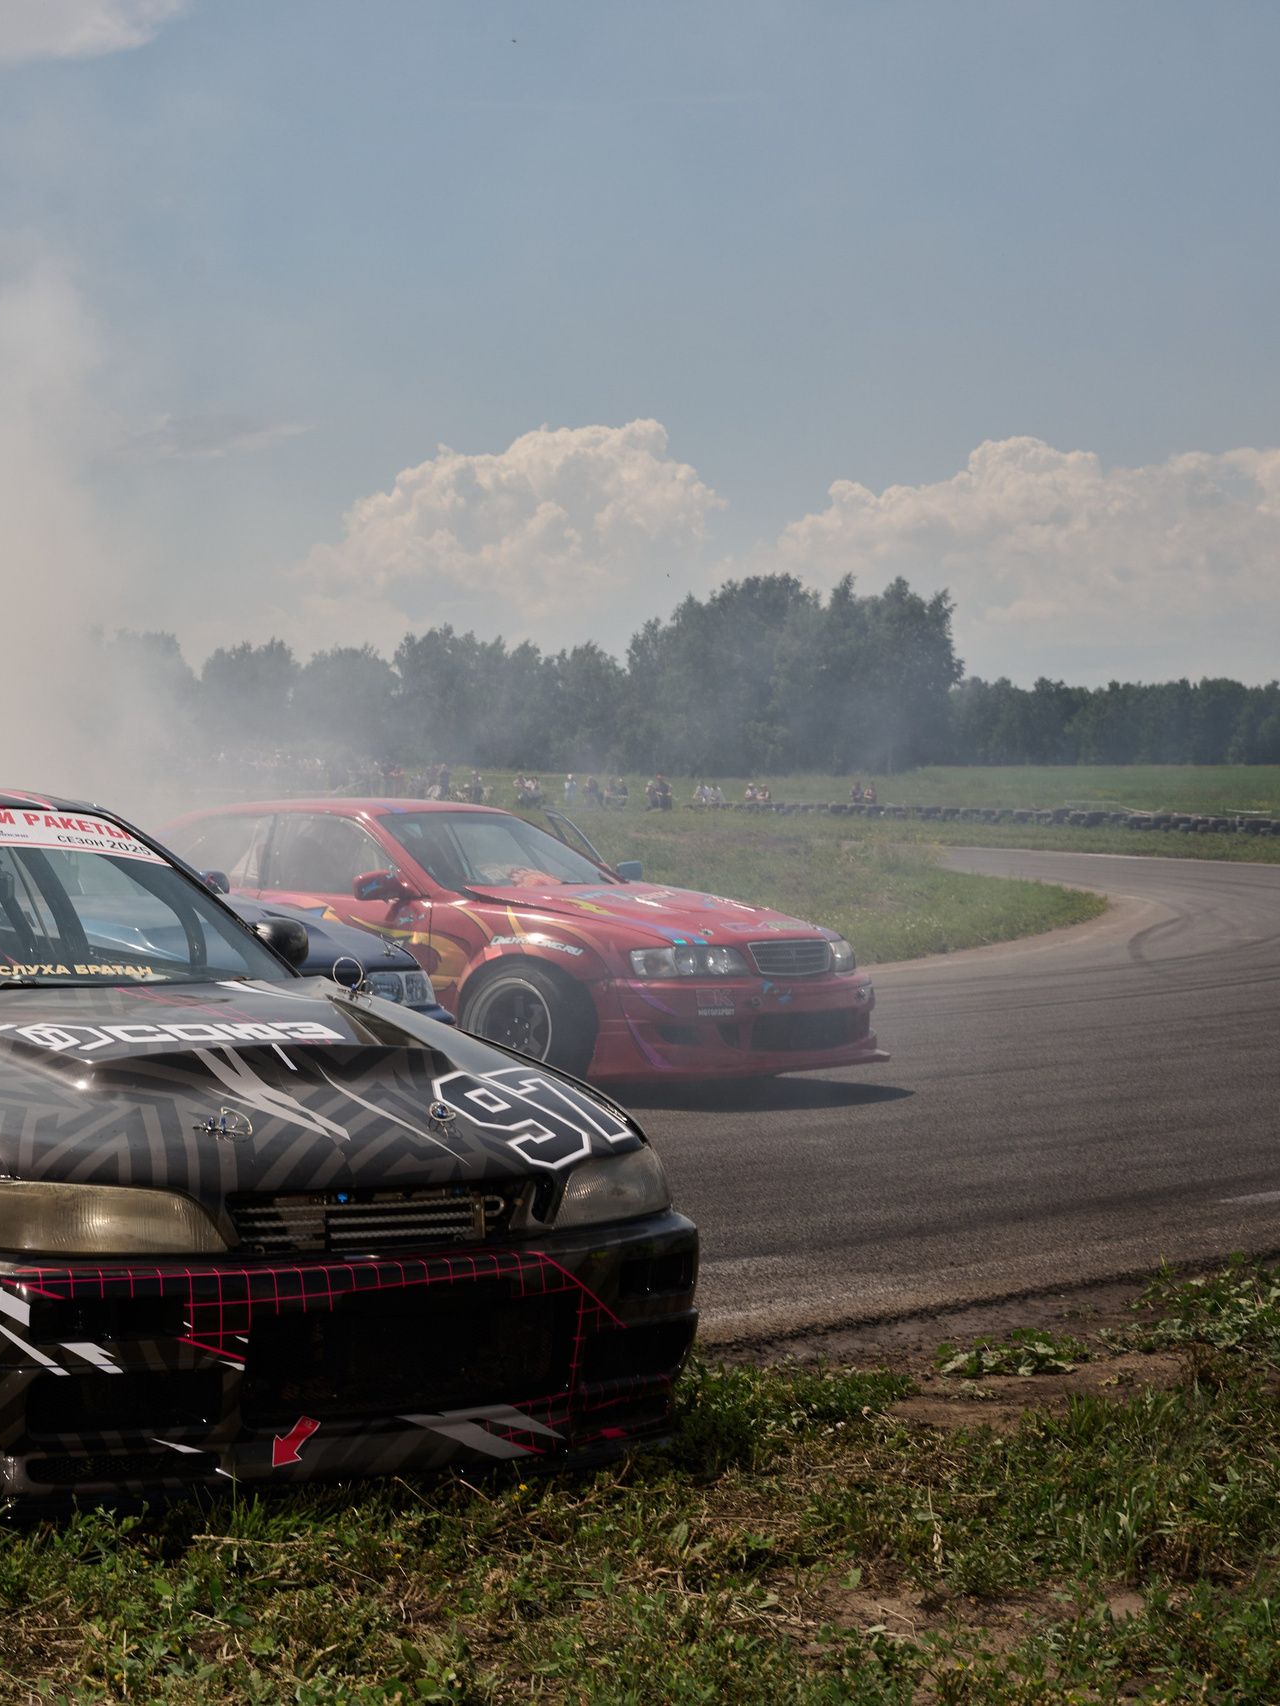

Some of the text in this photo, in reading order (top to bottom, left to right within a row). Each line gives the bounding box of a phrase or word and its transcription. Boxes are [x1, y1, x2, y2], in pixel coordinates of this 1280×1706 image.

[20, 813, 132, 841] РАКЕТЫ
[57, 834, 152, 856] СЕЗОН 2025
[74, 964, 154, 977] БРАТАН
[431, 1066, 634, 1171] 97
